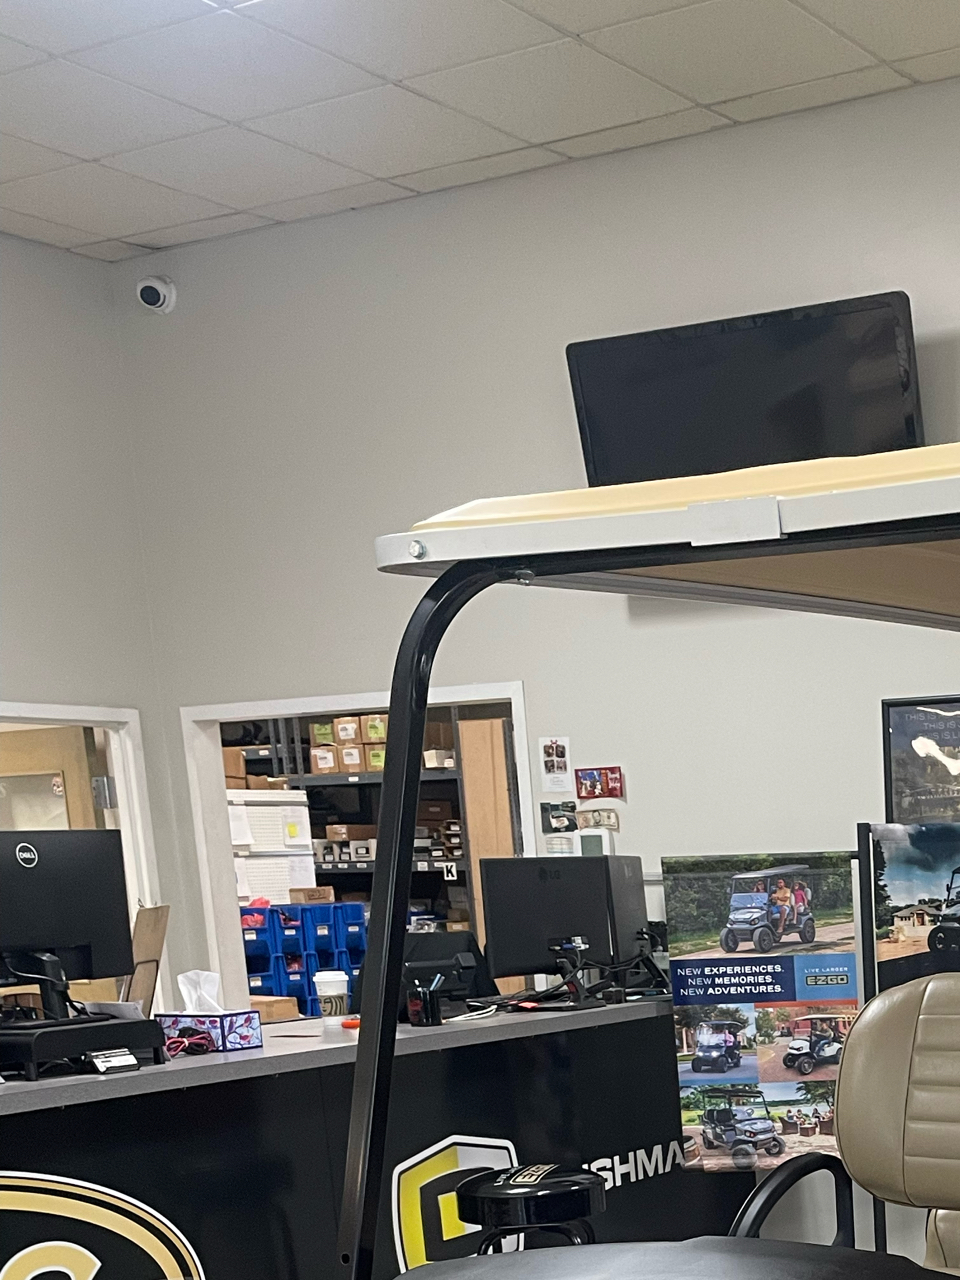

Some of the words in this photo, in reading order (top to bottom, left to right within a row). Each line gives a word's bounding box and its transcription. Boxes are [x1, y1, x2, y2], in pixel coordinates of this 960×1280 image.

[905, 713, 925, 721] THIS
[927, 712, 937, 720] IS
[923, 721, 945, 729] THIS
[946, 721, 956, 729] IS
[941, 731, 951, 739] IS
[445, 864, 455, 878] K
[677, 968, 701, 976] NEW
[704, 965, 784, 975] EXPERIENCES.
[688, 977, 712, 986] NEW
[714, 975, 775, 985] MEMORIES.
[680, 987, 704, 996] NEW
[706, 985, 784, 995] ADVENTURES.
[582, 1141, 685, 1190] SHMA
